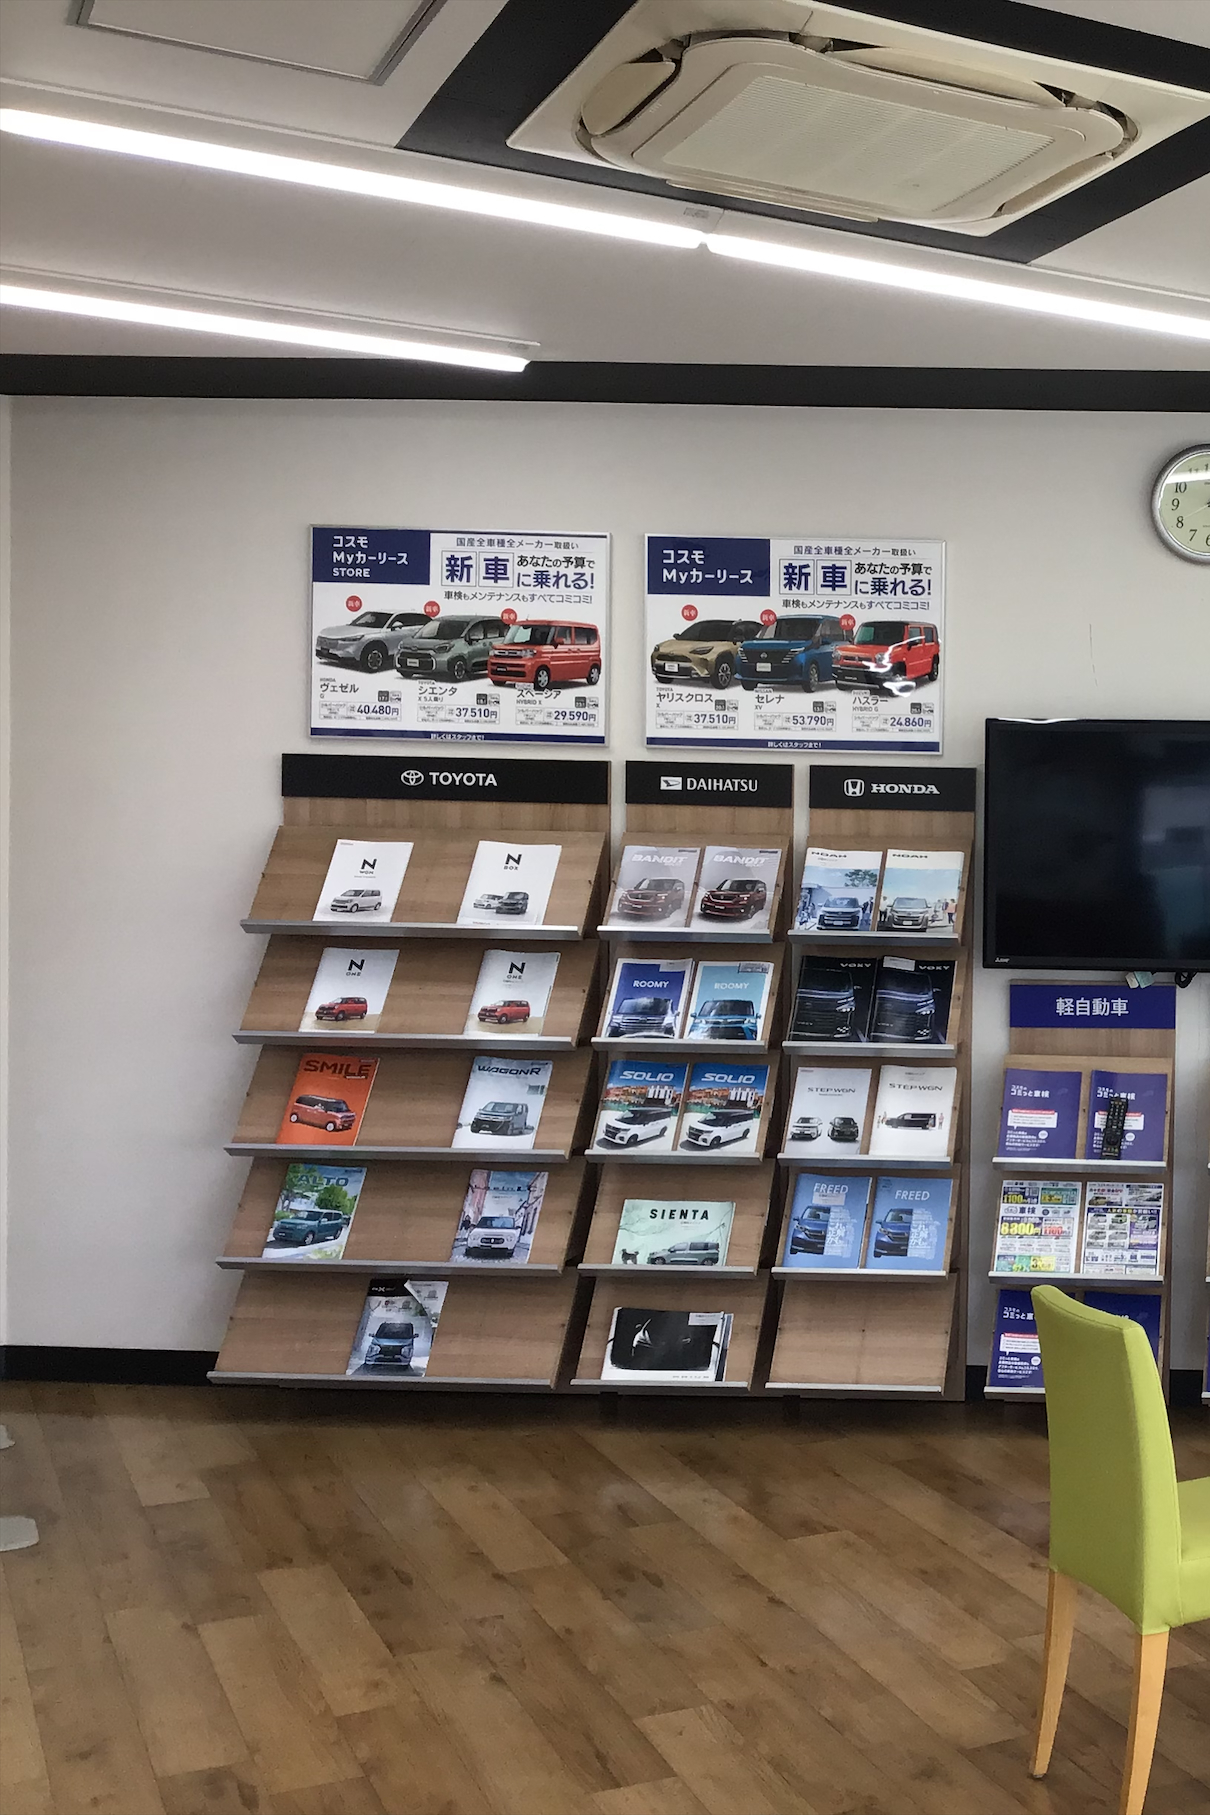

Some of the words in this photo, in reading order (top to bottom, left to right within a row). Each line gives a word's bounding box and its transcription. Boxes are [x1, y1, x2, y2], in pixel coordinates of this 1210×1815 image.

[1175, 482, 1187, 493] 10
[1172, 498, 1180, 511] 9
[1176, 516, 1184, 528] 8
[1189, 529, 1198, 542] 7
[332, 536, 368, 548] コスモ
[456, 538, 578, 550] 国産全車種全メーカー取扱い
[793, 545, 916, 556] 国産全車種全メーカー取扱い
[332, 551, 408, 567] Myカーリース
[517, 554, 595, 569] あなたの予算で
[662, 550, 704, 564] コスモ
[332, 568, 370, 578] STORE
[445, 554, 510, 584] 新車
[855, 562, 932, 576] あなたの予算で
[517, 571, 594, 590] に乗れる!
[662, 568, 753, 585] Myカーリース
[783, 562, 848, 592] 新車
[854, 578, 932, 596] に乗れる!
[320, 683, 359, 694] ヴェゼル
[418, 686, 457, 696] シエンタ
[656, 693, 714, 703] ヤリスクロス
[756, 694, 784, 704] セレナ
[852, 696, 888, 706] ハスラー
[429, 772, 498, 786] TOYOTA
[686, 778, 758, 792] DAIHATSU
[870, 783, 940, 794] HONDA
[361, 858, 378, 870] N
[505, 853, 522, 866] N
[632, 854, 688, 864] BANDIT
[713, 854, 769, 864] BANDIT
[348, 959, 364, 971] N
[508, 962, 526, 974] N
[632, 980, 670, 988] ROOMY
[1056, 998, 1130, 1016] 軽自動車
[304, 1060, 372, 1077] SMILE
[620, 1070, 674, 1082] SOLIO
[702, 1072, 756, 1084] SOLIO
[300, 1174, 350, 1188] ALTO
[813, 1182, 849, 1194] FREED
[894, 1190, 930, 1201] FREED
[650, 1208, 710, 1220] SIENTA
